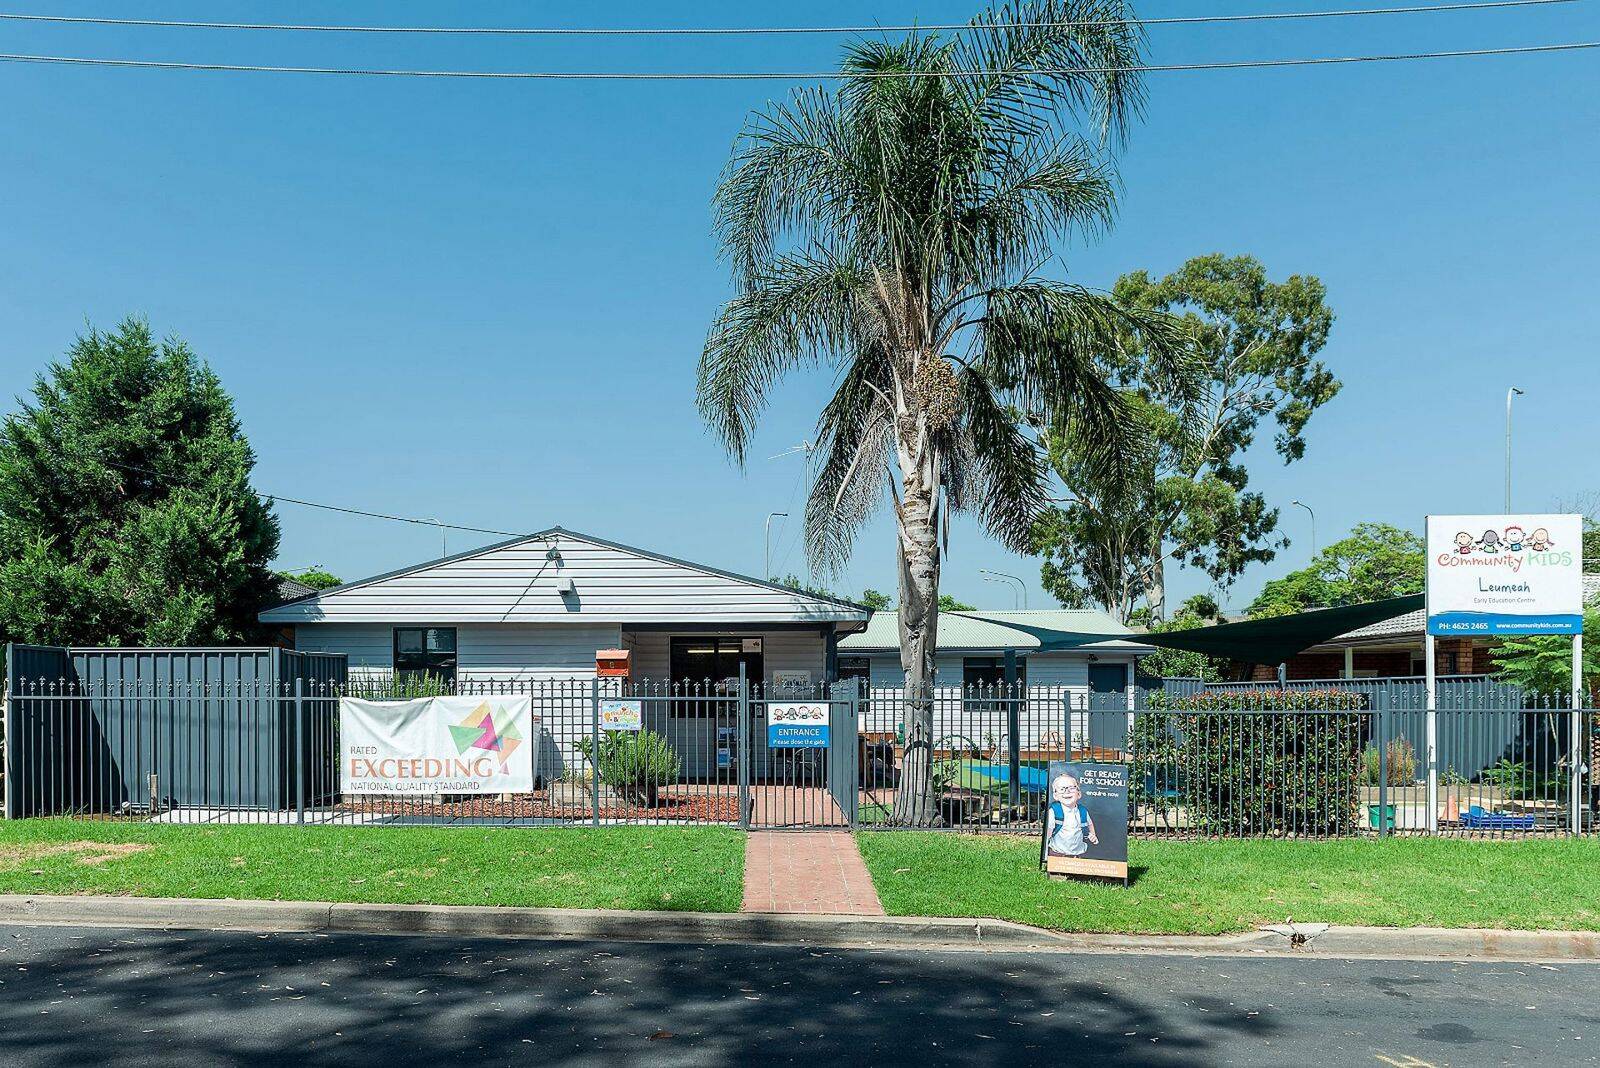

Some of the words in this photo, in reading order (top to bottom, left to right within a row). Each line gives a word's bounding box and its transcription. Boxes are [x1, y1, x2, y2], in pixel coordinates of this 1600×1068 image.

[1526, 551, 1572, 567] KIDS
[1478, 577, 1530, 594] Leumeah
[350, 746, 377, 755] RATED
[351, 758, 493, 779] EXCEEDING
[350, 782, 393, 791] NATIONAL
[396, 782, 433, 791] QUALITY
[434, 781, 480, 790] STANDARD
